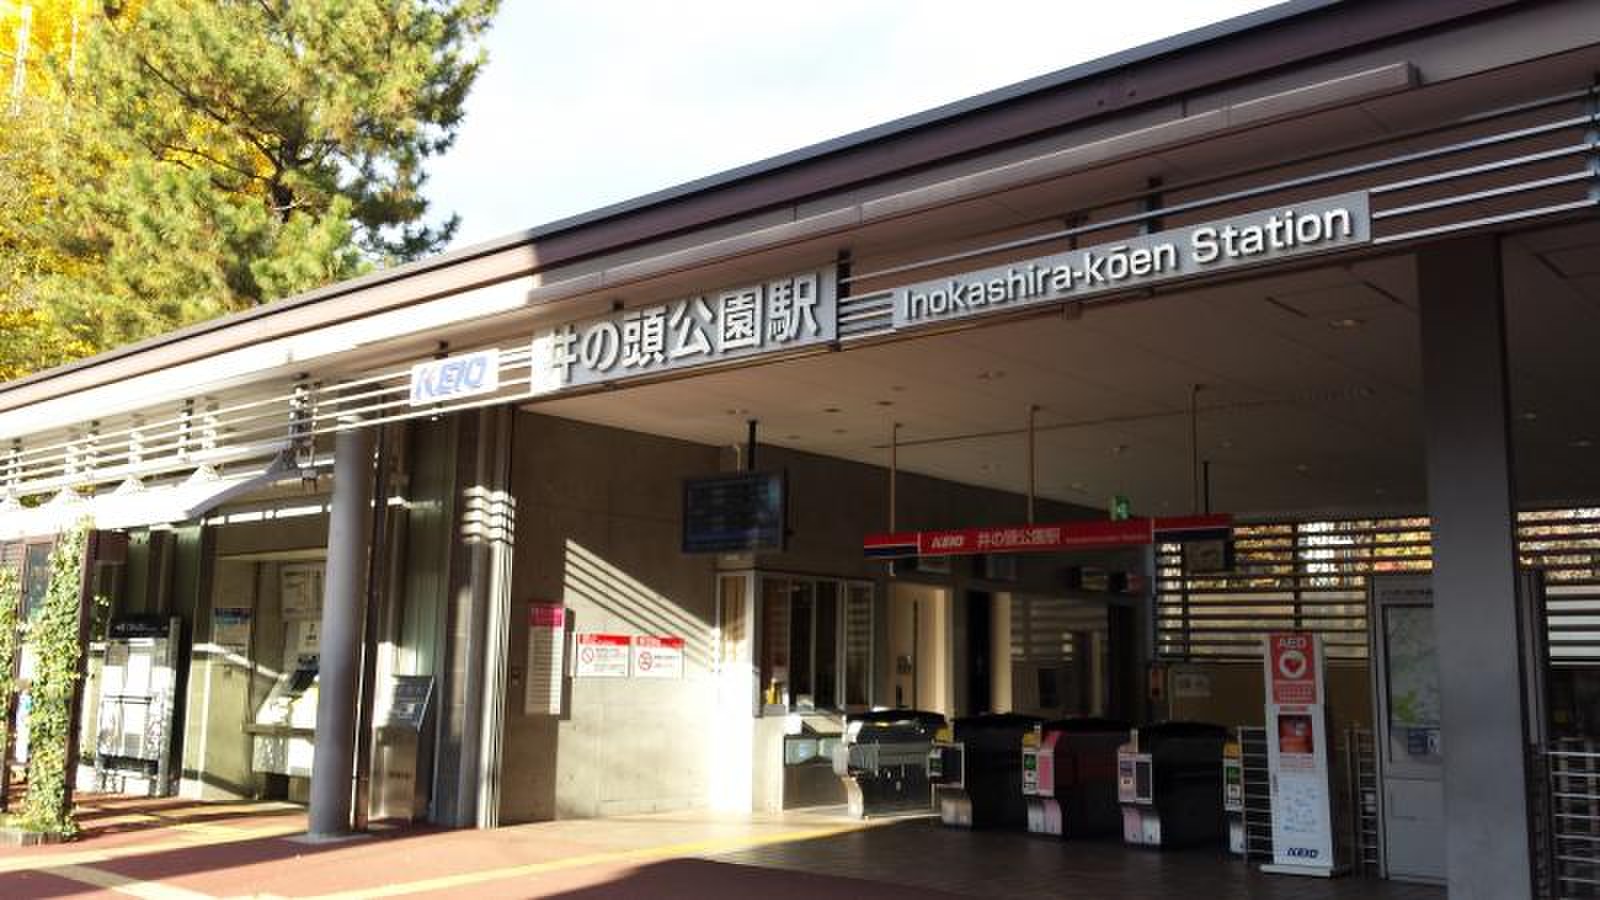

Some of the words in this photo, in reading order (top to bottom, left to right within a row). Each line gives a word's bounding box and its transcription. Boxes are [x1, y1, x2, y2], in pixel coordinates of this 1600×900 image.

[902, 243, 1176, 320] Inokashira-kōen
[1191, 206, 1351, 264] Station
[415, 356, 487, 401] KEIO
[544, 272, 818, 382] 井の頭公園駅
